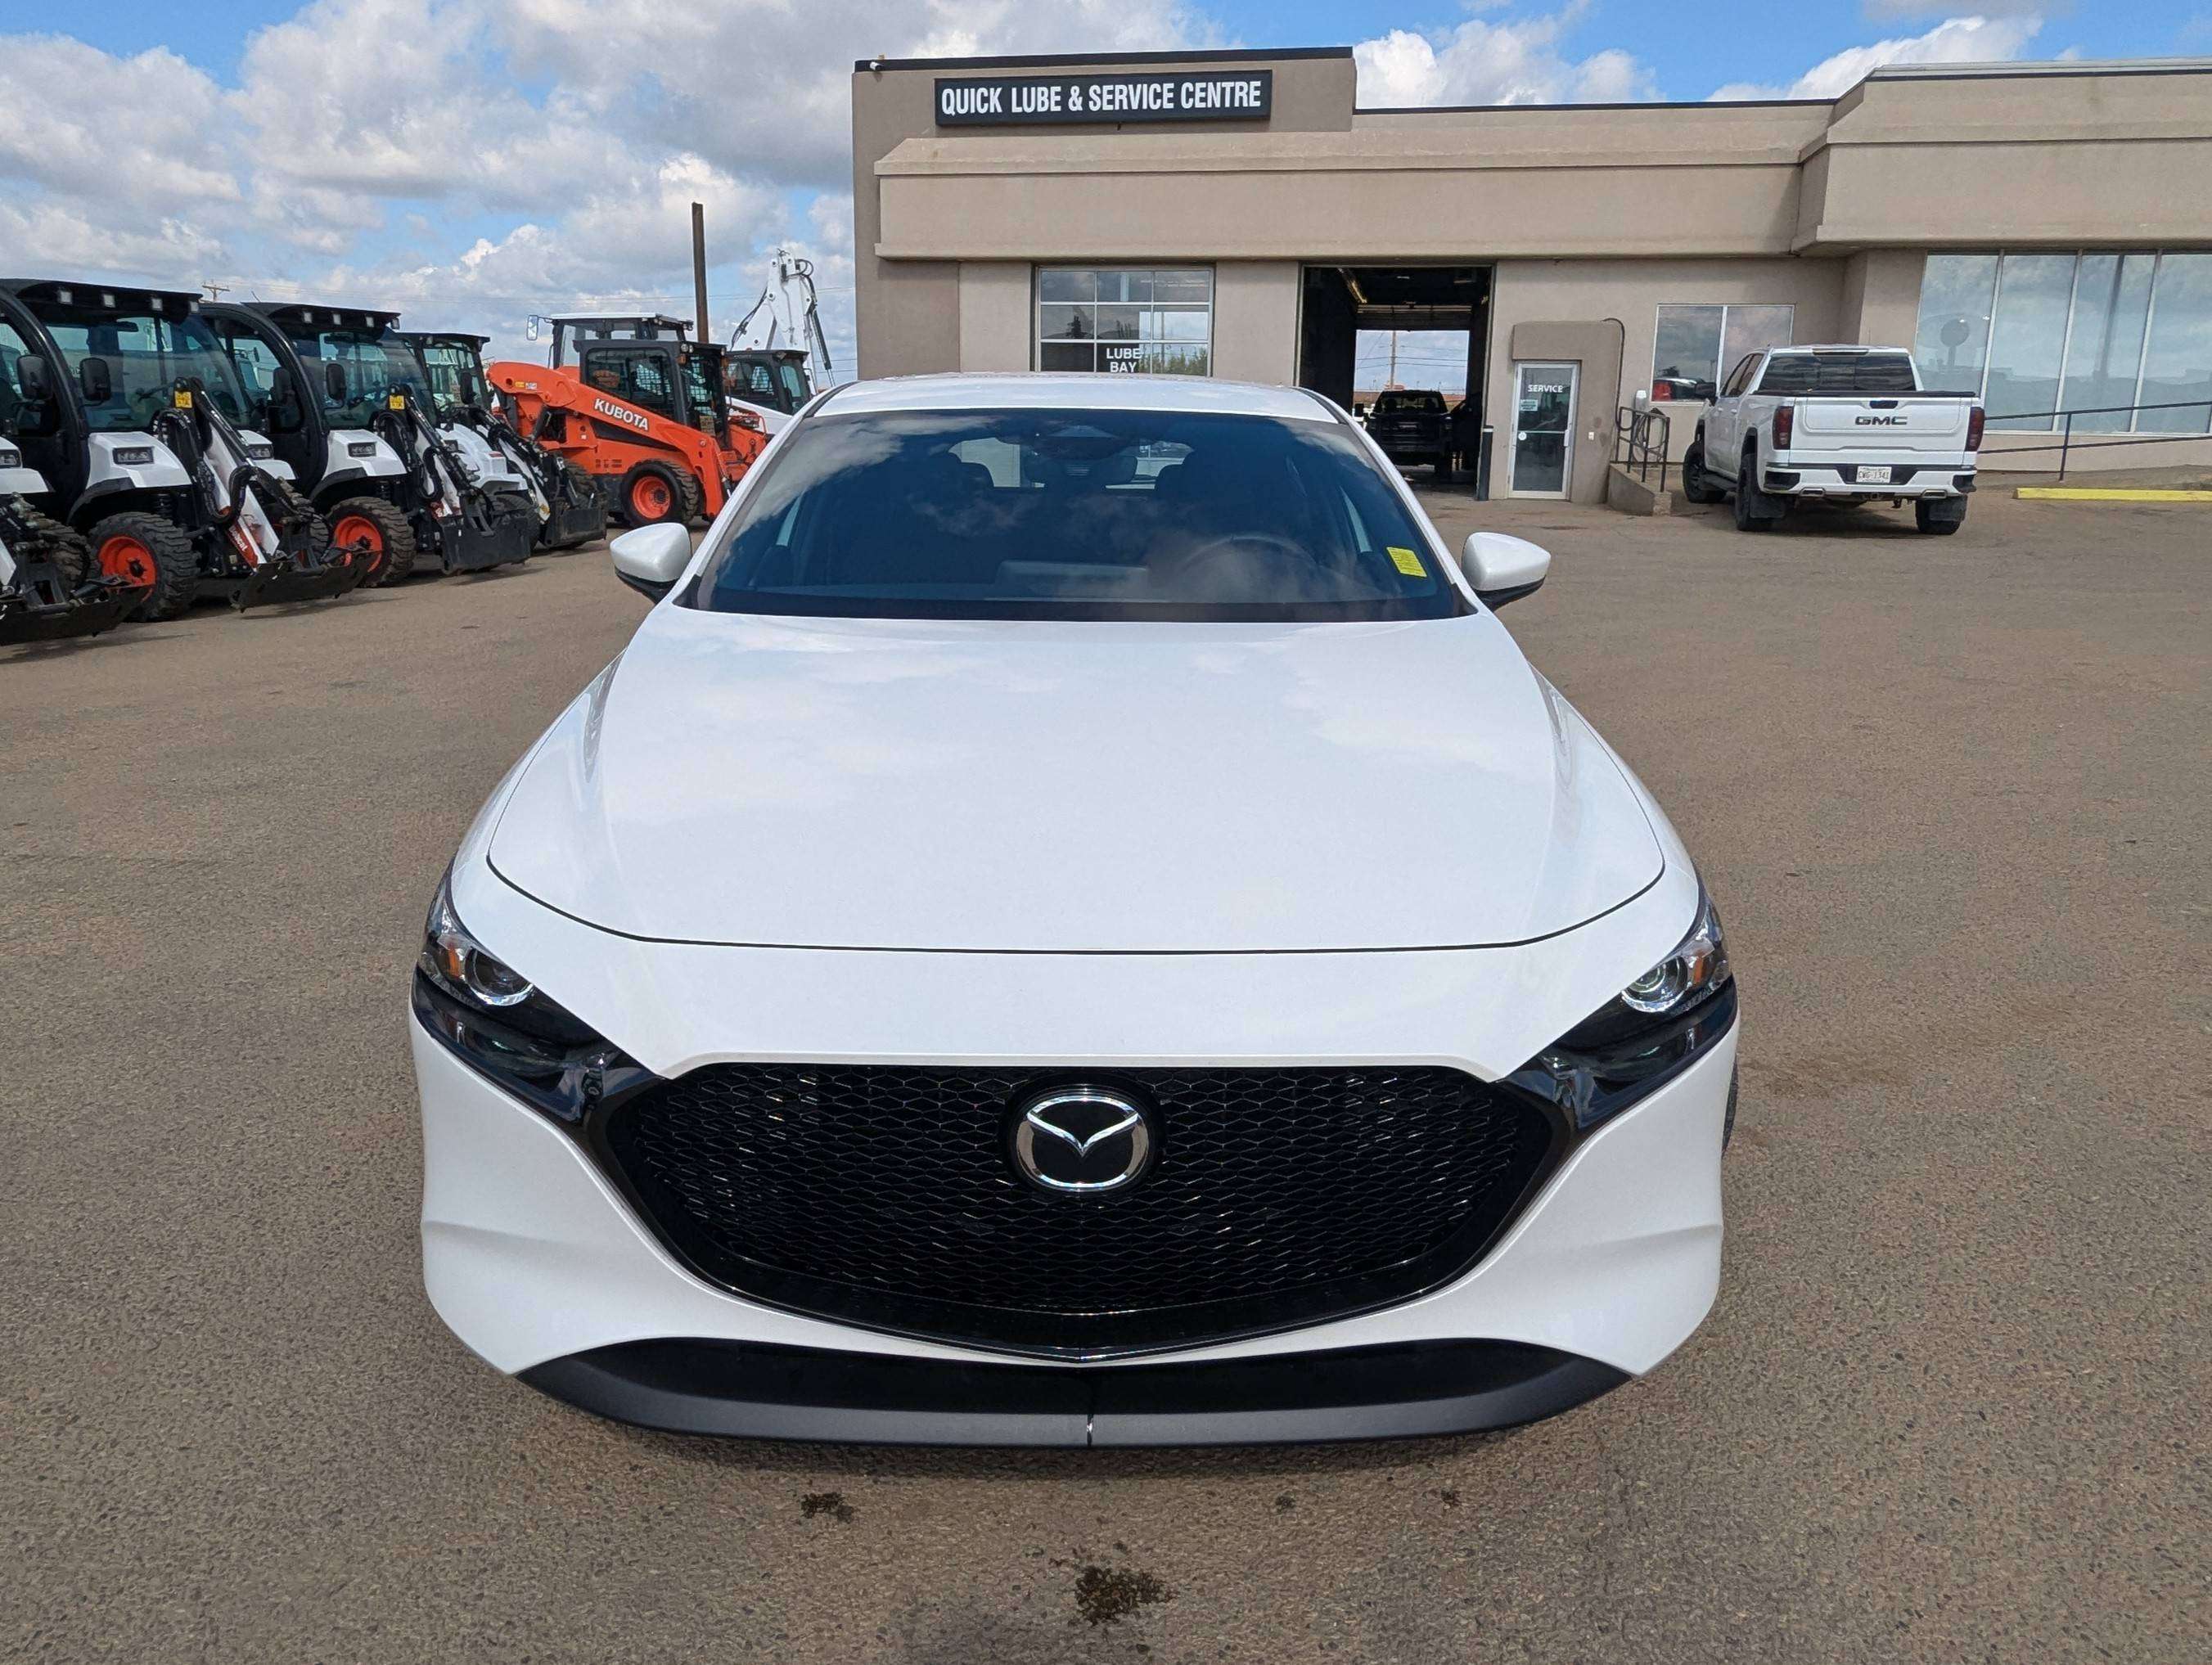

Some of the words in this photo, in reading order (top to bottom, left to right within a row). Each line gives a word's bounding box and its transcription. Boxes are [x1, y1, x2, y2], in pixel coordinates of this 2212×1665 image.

[942, 87, 1002, 115] QUICK
[1011, 86, 1061, 113] LUBE
[1068, 85, 1083, 111] &
[1088, 83, 1175, 111] SERVICE
[1180, 80, 1262, 109] CENTRE
[1106, 348, 1142, 360] LUBE
[1110, 362, 1137, 373] BAY
[1527, 385, 1563, 393] SERVICE
[594, 398, 648, 430] KUBOTA
[1855, 416, 1908, 425] GMC
